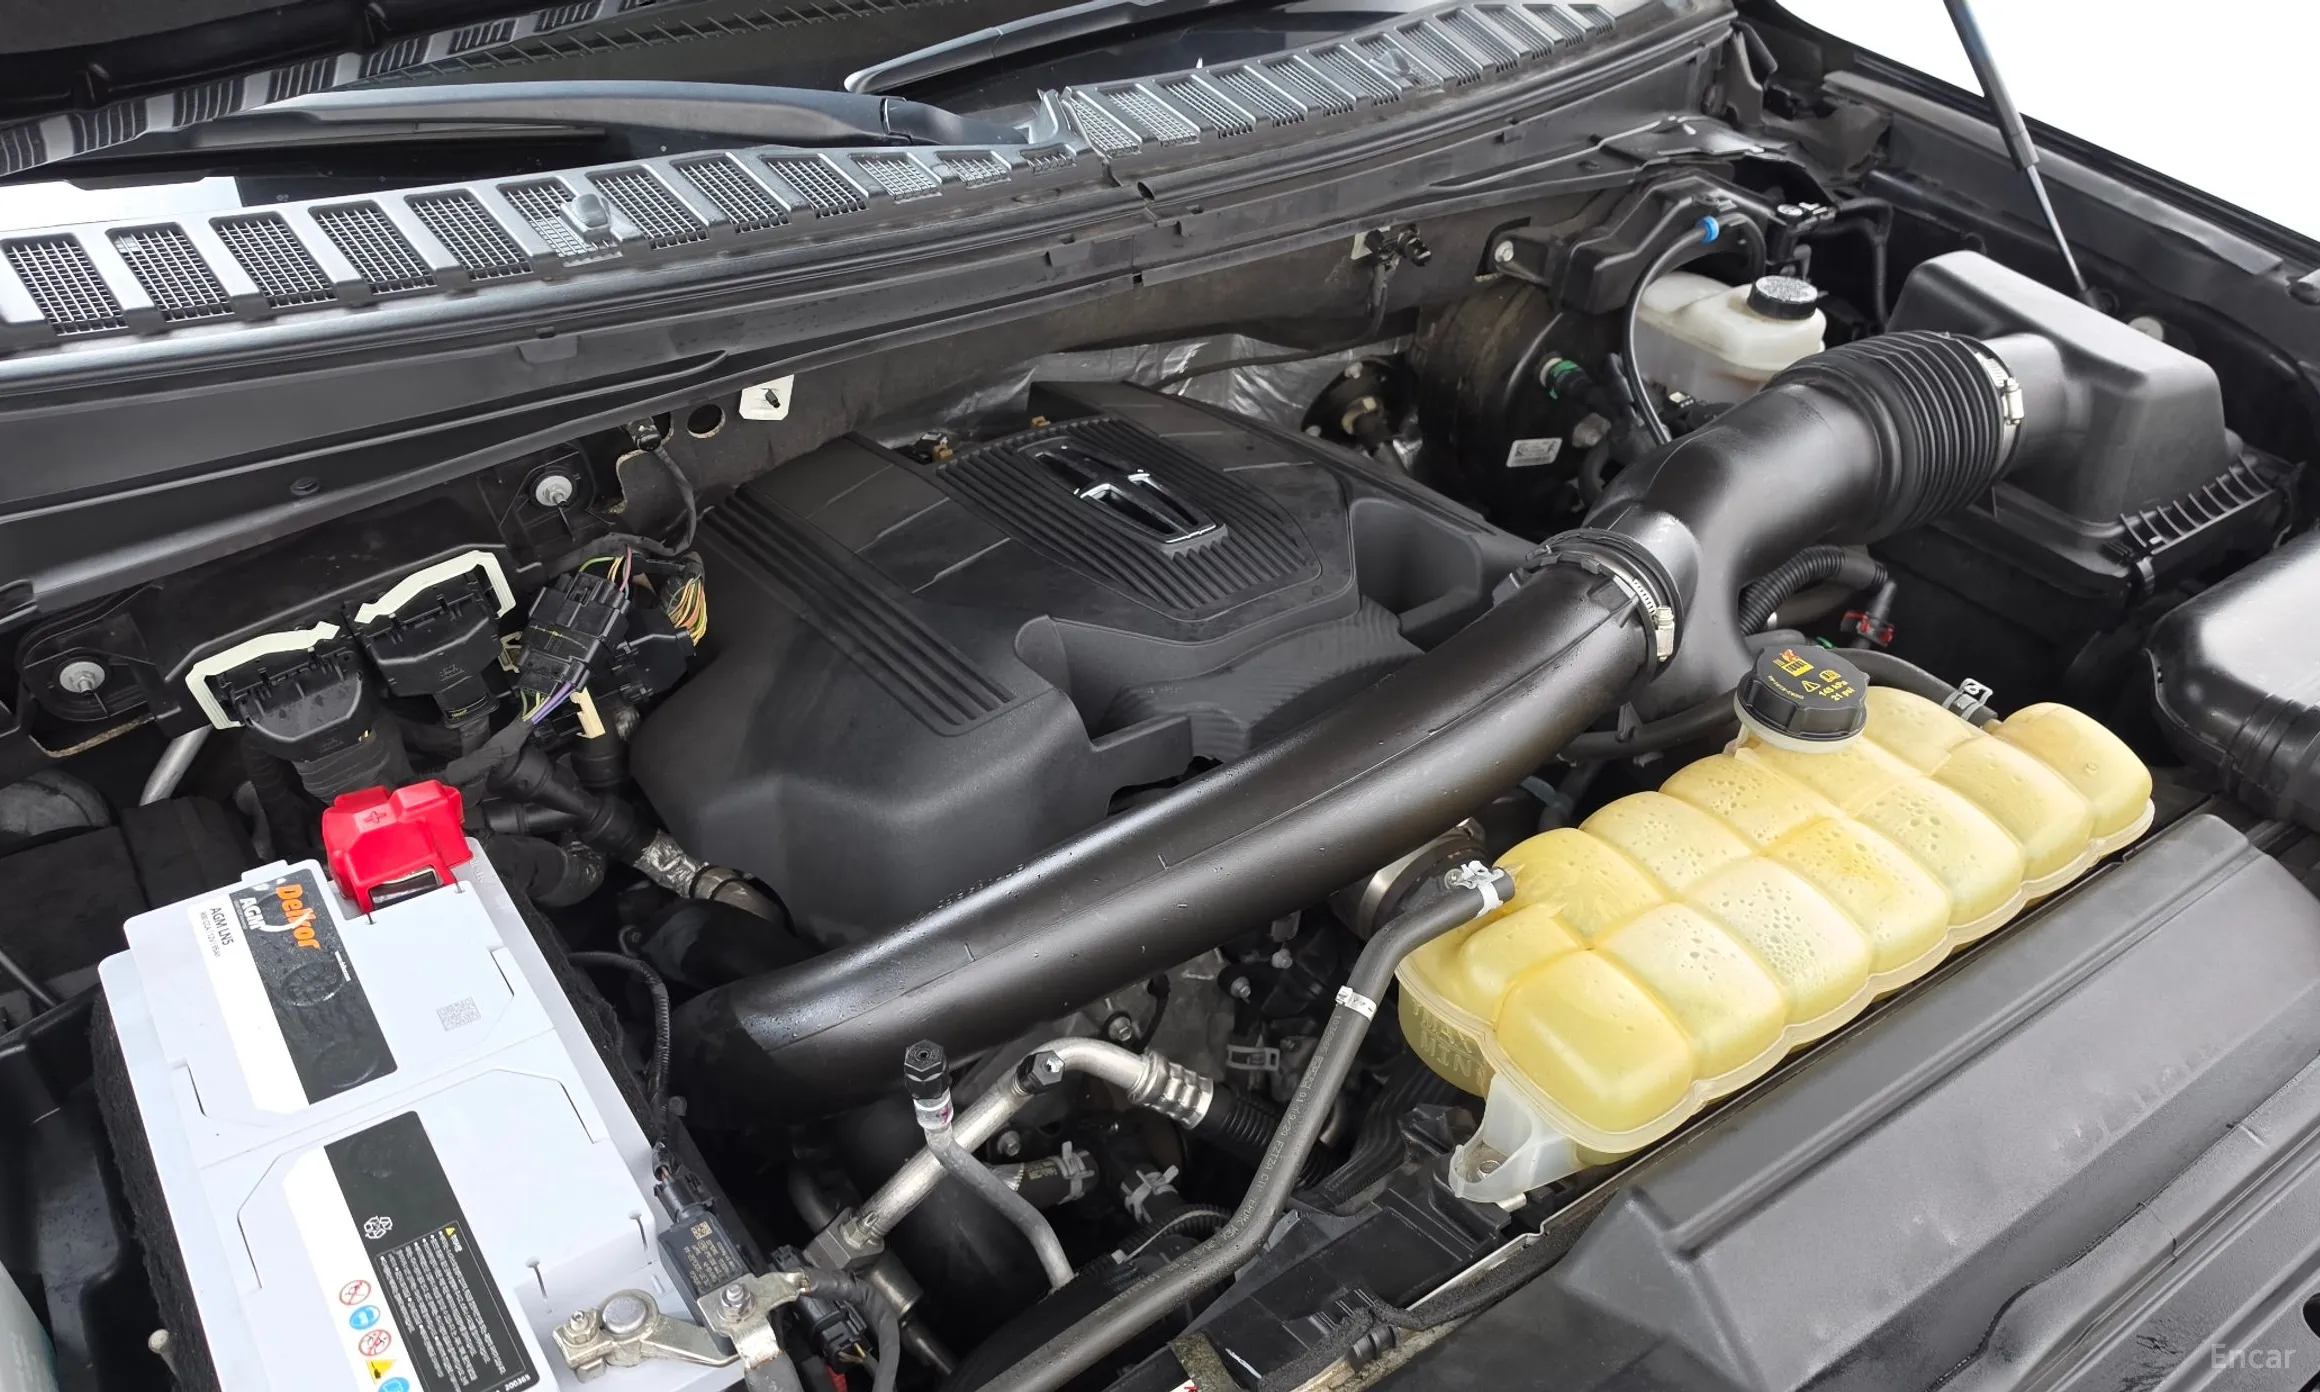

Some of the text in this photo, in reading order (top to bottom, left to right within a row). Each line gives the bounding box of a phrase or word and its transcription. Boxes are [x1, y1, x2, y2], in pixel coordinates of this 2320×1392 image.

[210, 907, 234, 946] AGM LN5
[239, 897, 266, 930] AGM
[1421, 1029, 1472, 1078] MIN
